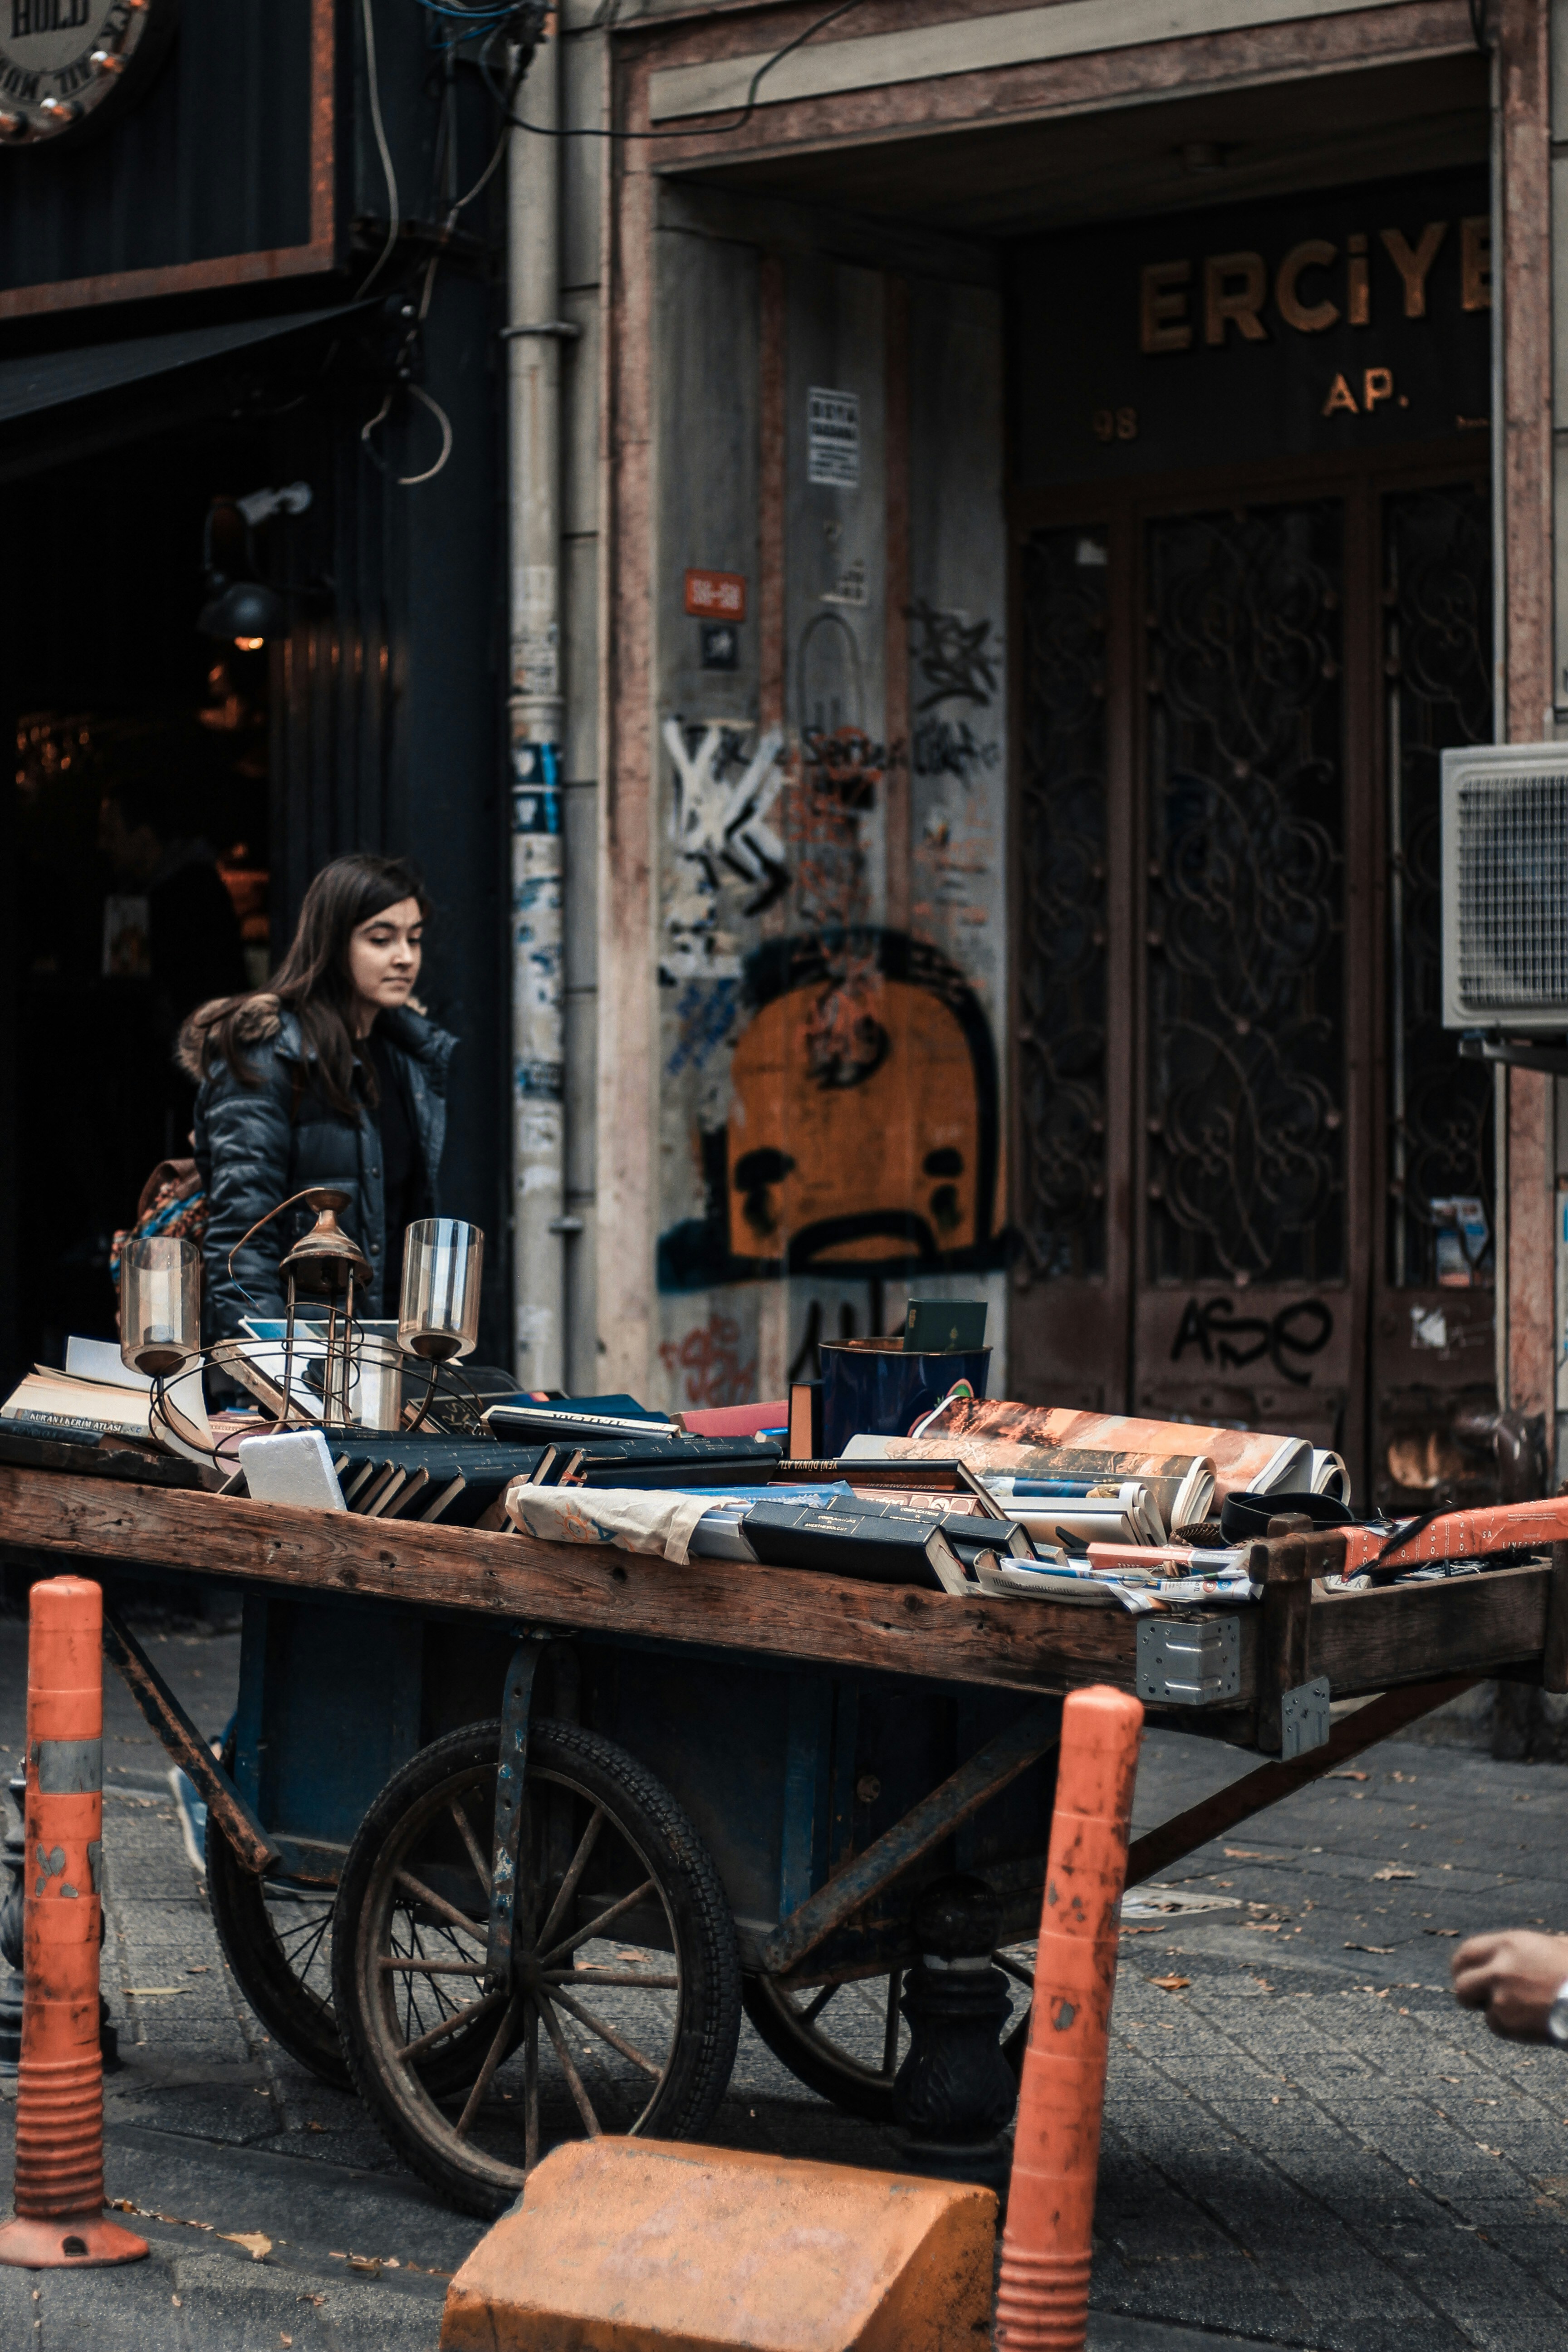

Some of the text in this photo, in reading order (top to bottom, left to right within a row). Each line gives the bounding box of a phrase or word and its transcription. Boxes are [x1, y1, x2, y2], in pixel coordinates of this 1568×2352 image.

[1321, 368, 1409, 416] AP.
[794, 1460, 820, 1471] DÜNYA
[820, 1460, 838, 1471] YENİ
